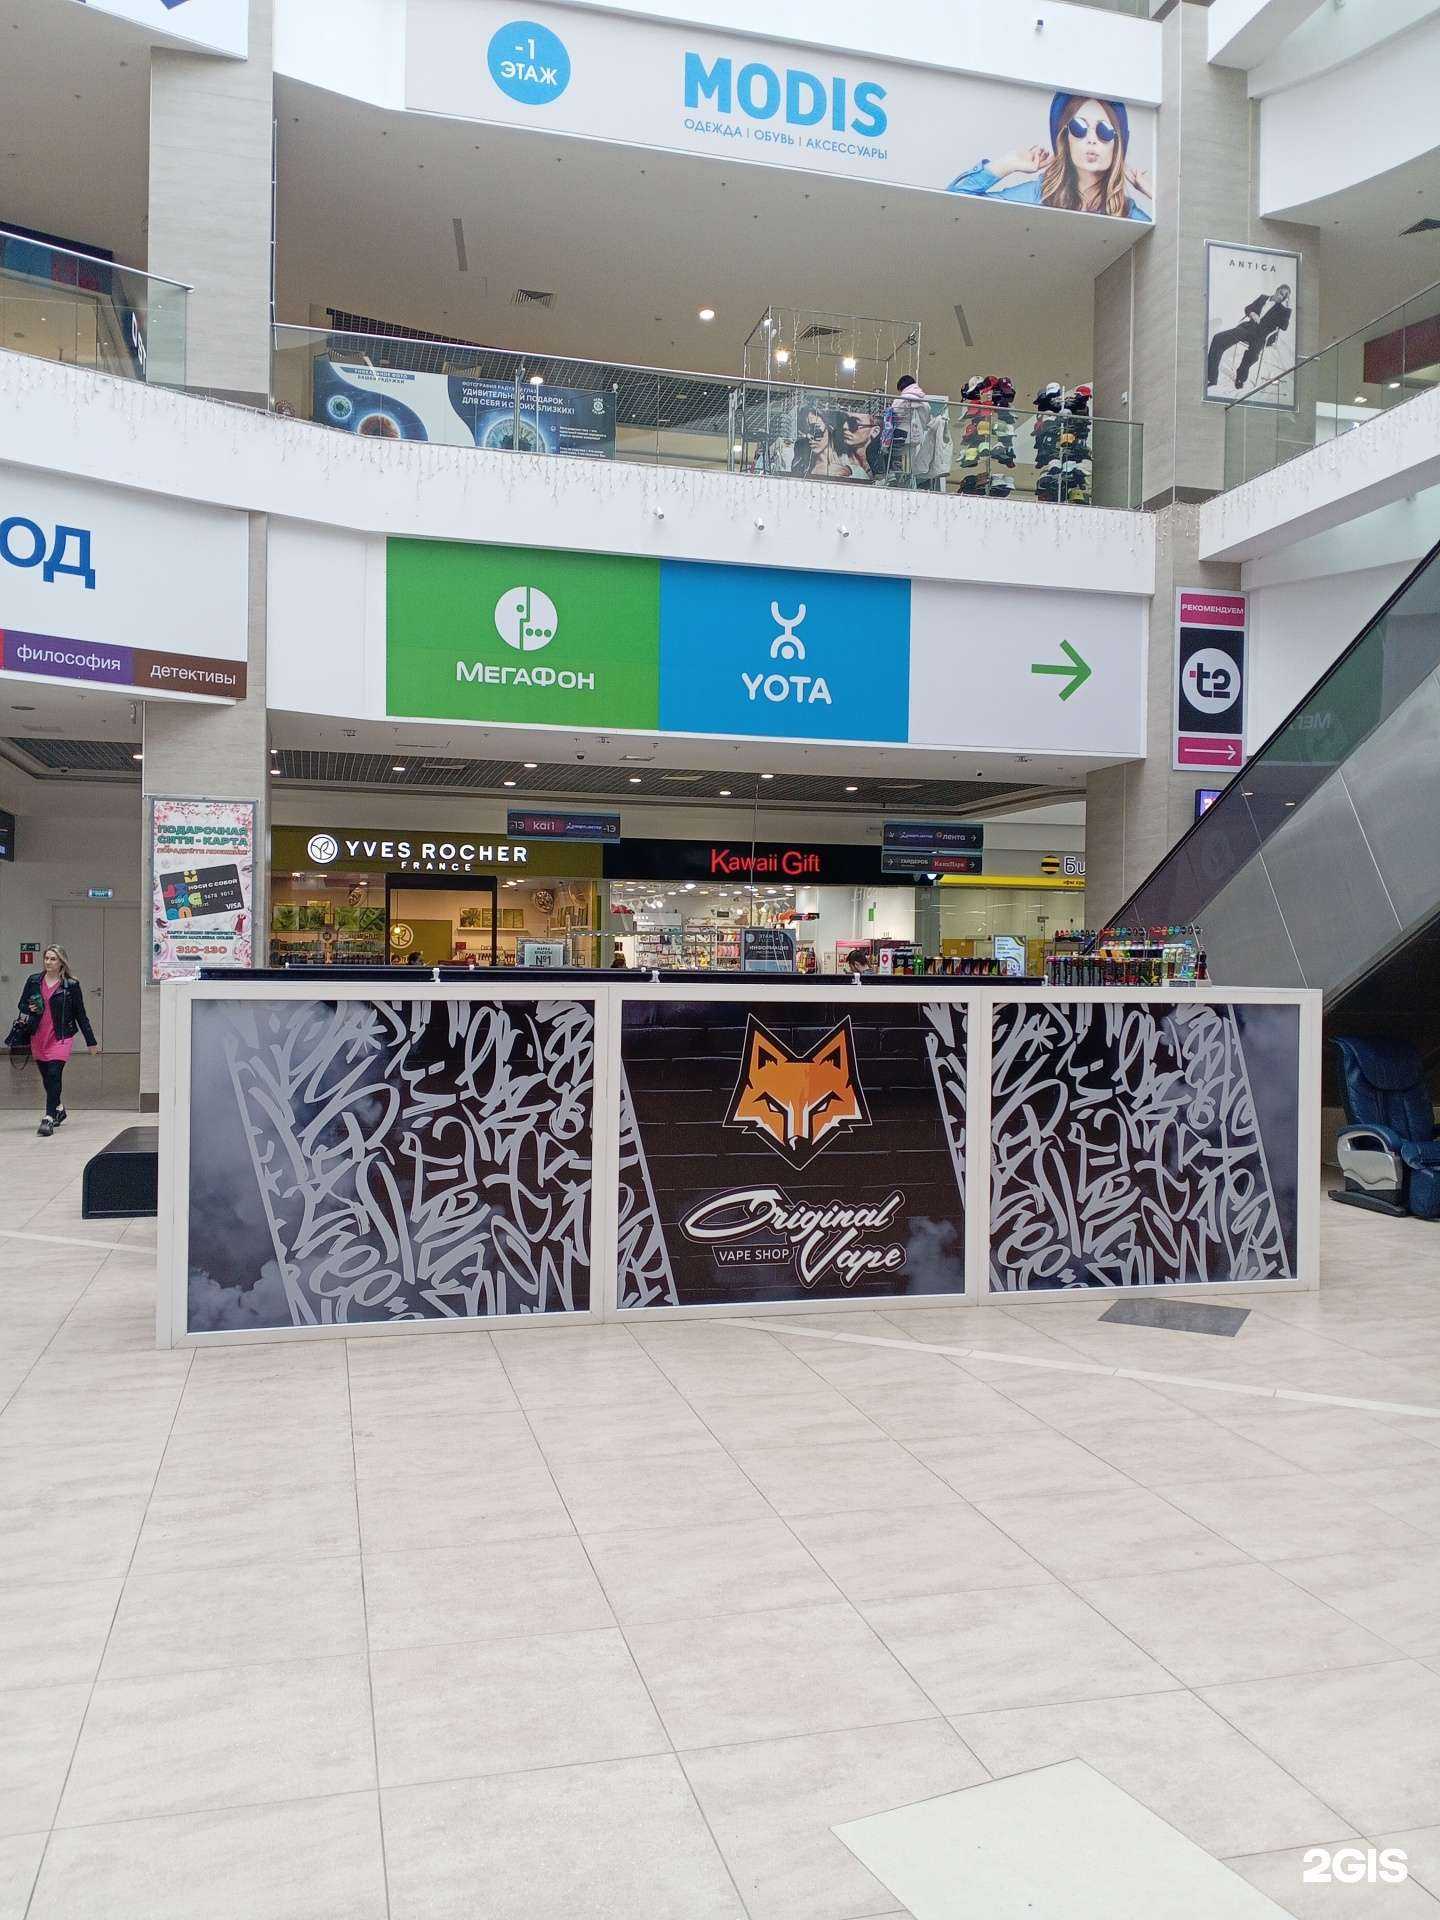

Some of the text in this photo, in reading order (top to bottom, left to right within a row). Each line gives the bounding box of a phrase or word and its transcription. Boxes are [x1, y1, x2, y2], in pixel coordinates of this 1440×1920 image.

[514, 38, 537, 60] -1
[499, 60, 559, 86] ЭТАЖ
[683, 51, 888, 138] MODIS
[683, 117, 888, 160] ОДЕЖДА ОБУВЬ АКСЕССУАРЫ
[462, 388, 564, 406] УДИВИТЕЛЬНЙ ПОДАРОК
[462, 397, 479, 405] ДЛЯ
[479, 398, 501, 407] СЕБЯ
[508, 402, 535, 411] СОИХ
[1181, 603, 1244, 615] РЕКОМЕНДУЕМ
[16, 643, 237, 686] философия детективы
[741, 671, 833, 705] YOTA
[157, 824, 248, 836] ПОДАРОЧНАЯ
[157, 835, 195, 845] СИТИ
[202, 836, 249, 846] КАРТА
[345, 840, 528, 862] YVES ROCHER
[711, 848, 820, 875] Kawaii Gift
[400, 861, 472, 872] FRANCE
[225, 901, 242, 910] VISA
[685, 1189, 900, 1243] Original
[718, 1249, 790, 1263] VAPE SHOP
[799, 1227, 902, 1284] Vape
